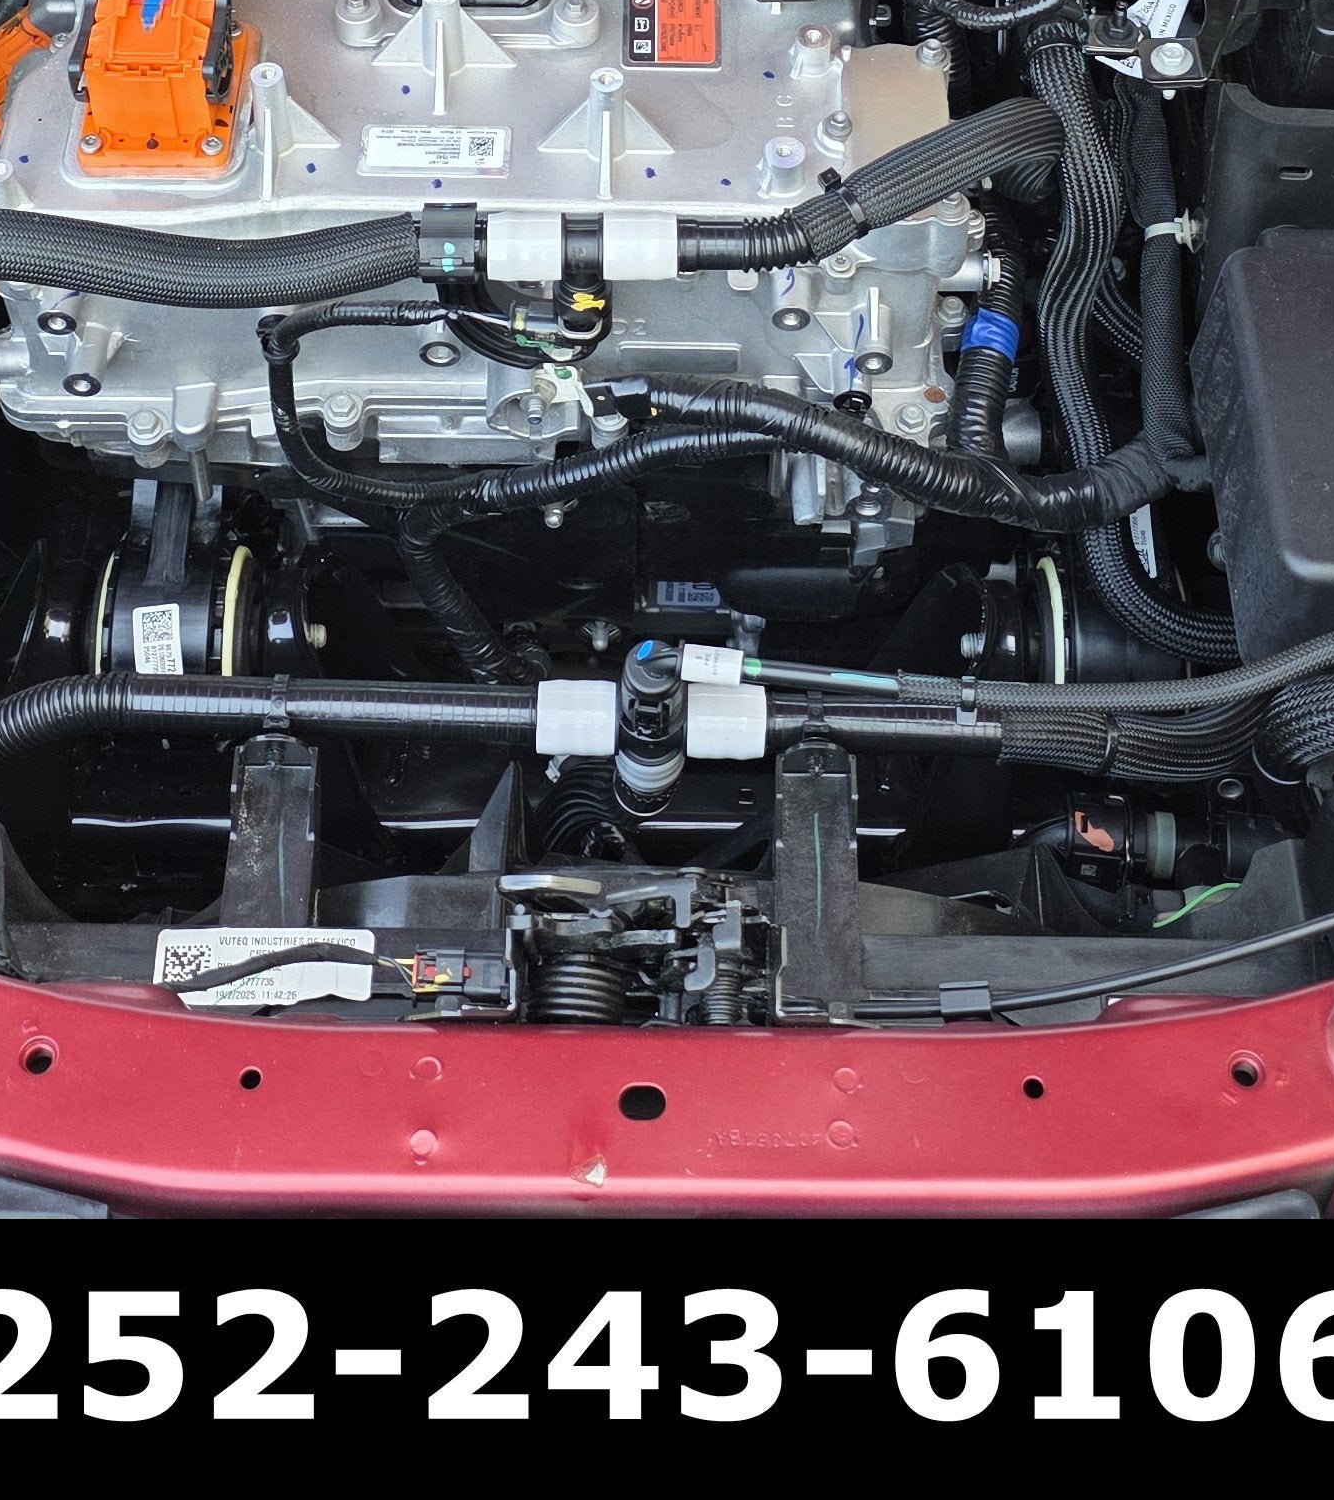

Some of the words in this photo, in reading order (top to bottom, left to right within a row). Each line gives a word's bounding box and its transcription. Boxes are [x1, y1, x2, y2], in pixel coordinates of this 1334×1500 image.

[1162, 3, 1177, 27] MEXICO
[219, 937, 248, 946] VUTEQ
[252, 937, 304, 946] INDUSTRIES
[216, 991, 256, 1000] 19/2/2025
[262, 991, 297, 1000] 11:42:26
